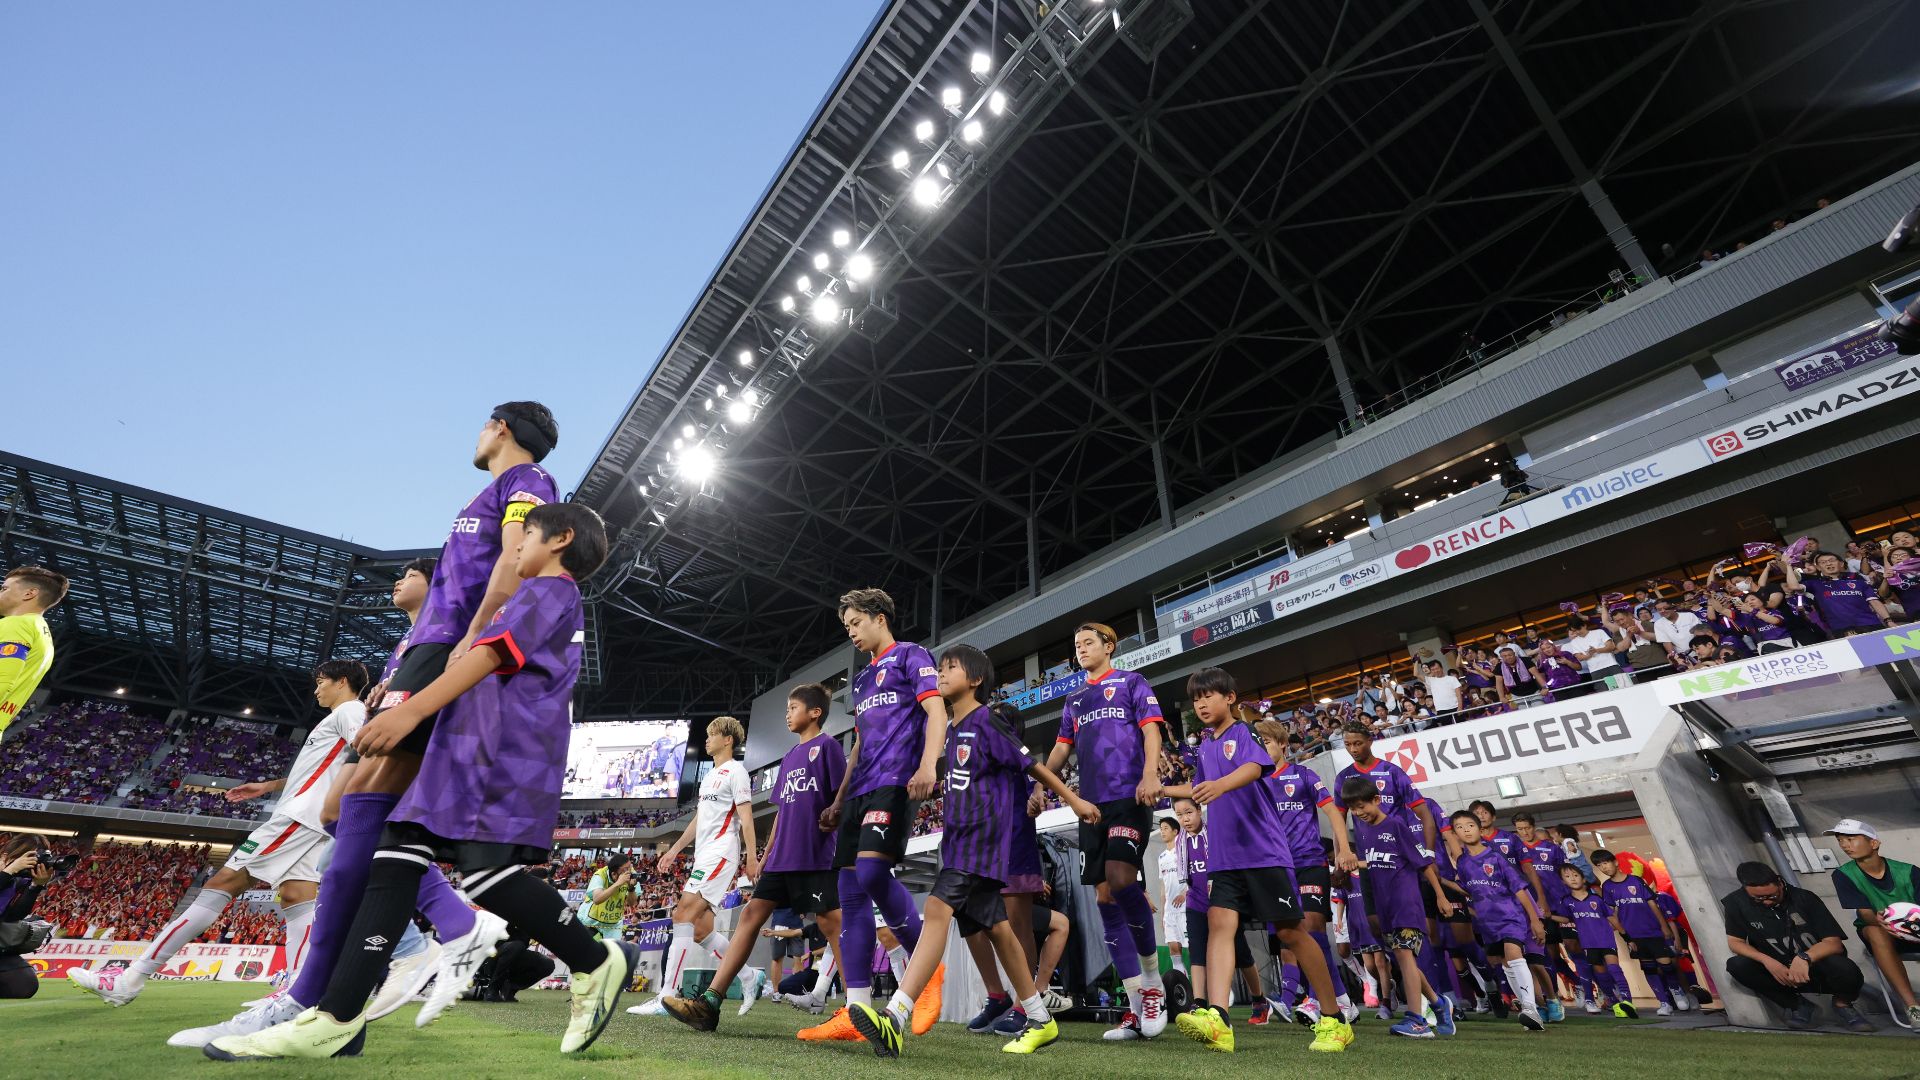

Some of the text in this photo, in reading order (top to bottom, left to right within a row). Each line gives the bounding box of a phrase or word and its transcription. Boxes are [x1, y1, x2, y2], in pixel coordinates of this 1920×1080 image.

[1434, 515, 1516, 557] RENCA
[1268, 570, 1290, 591] JTB
[1351, 566, 1376, 581] KSN
[1285, 583, 1336, 608] 日本クリニック
[1230, 608, 1261, 630] 岡本
[1747, 650, 1824, 674] NIPPON
[1752, 660, 1829, 683] EXPRESS
[1678, 666, 1751, 697] NX
[1078, 707, 1125, 727] KYOCERA
[1428, 705, 1632, 772] KYOCERA
[204, 946, 231, 956] THE
